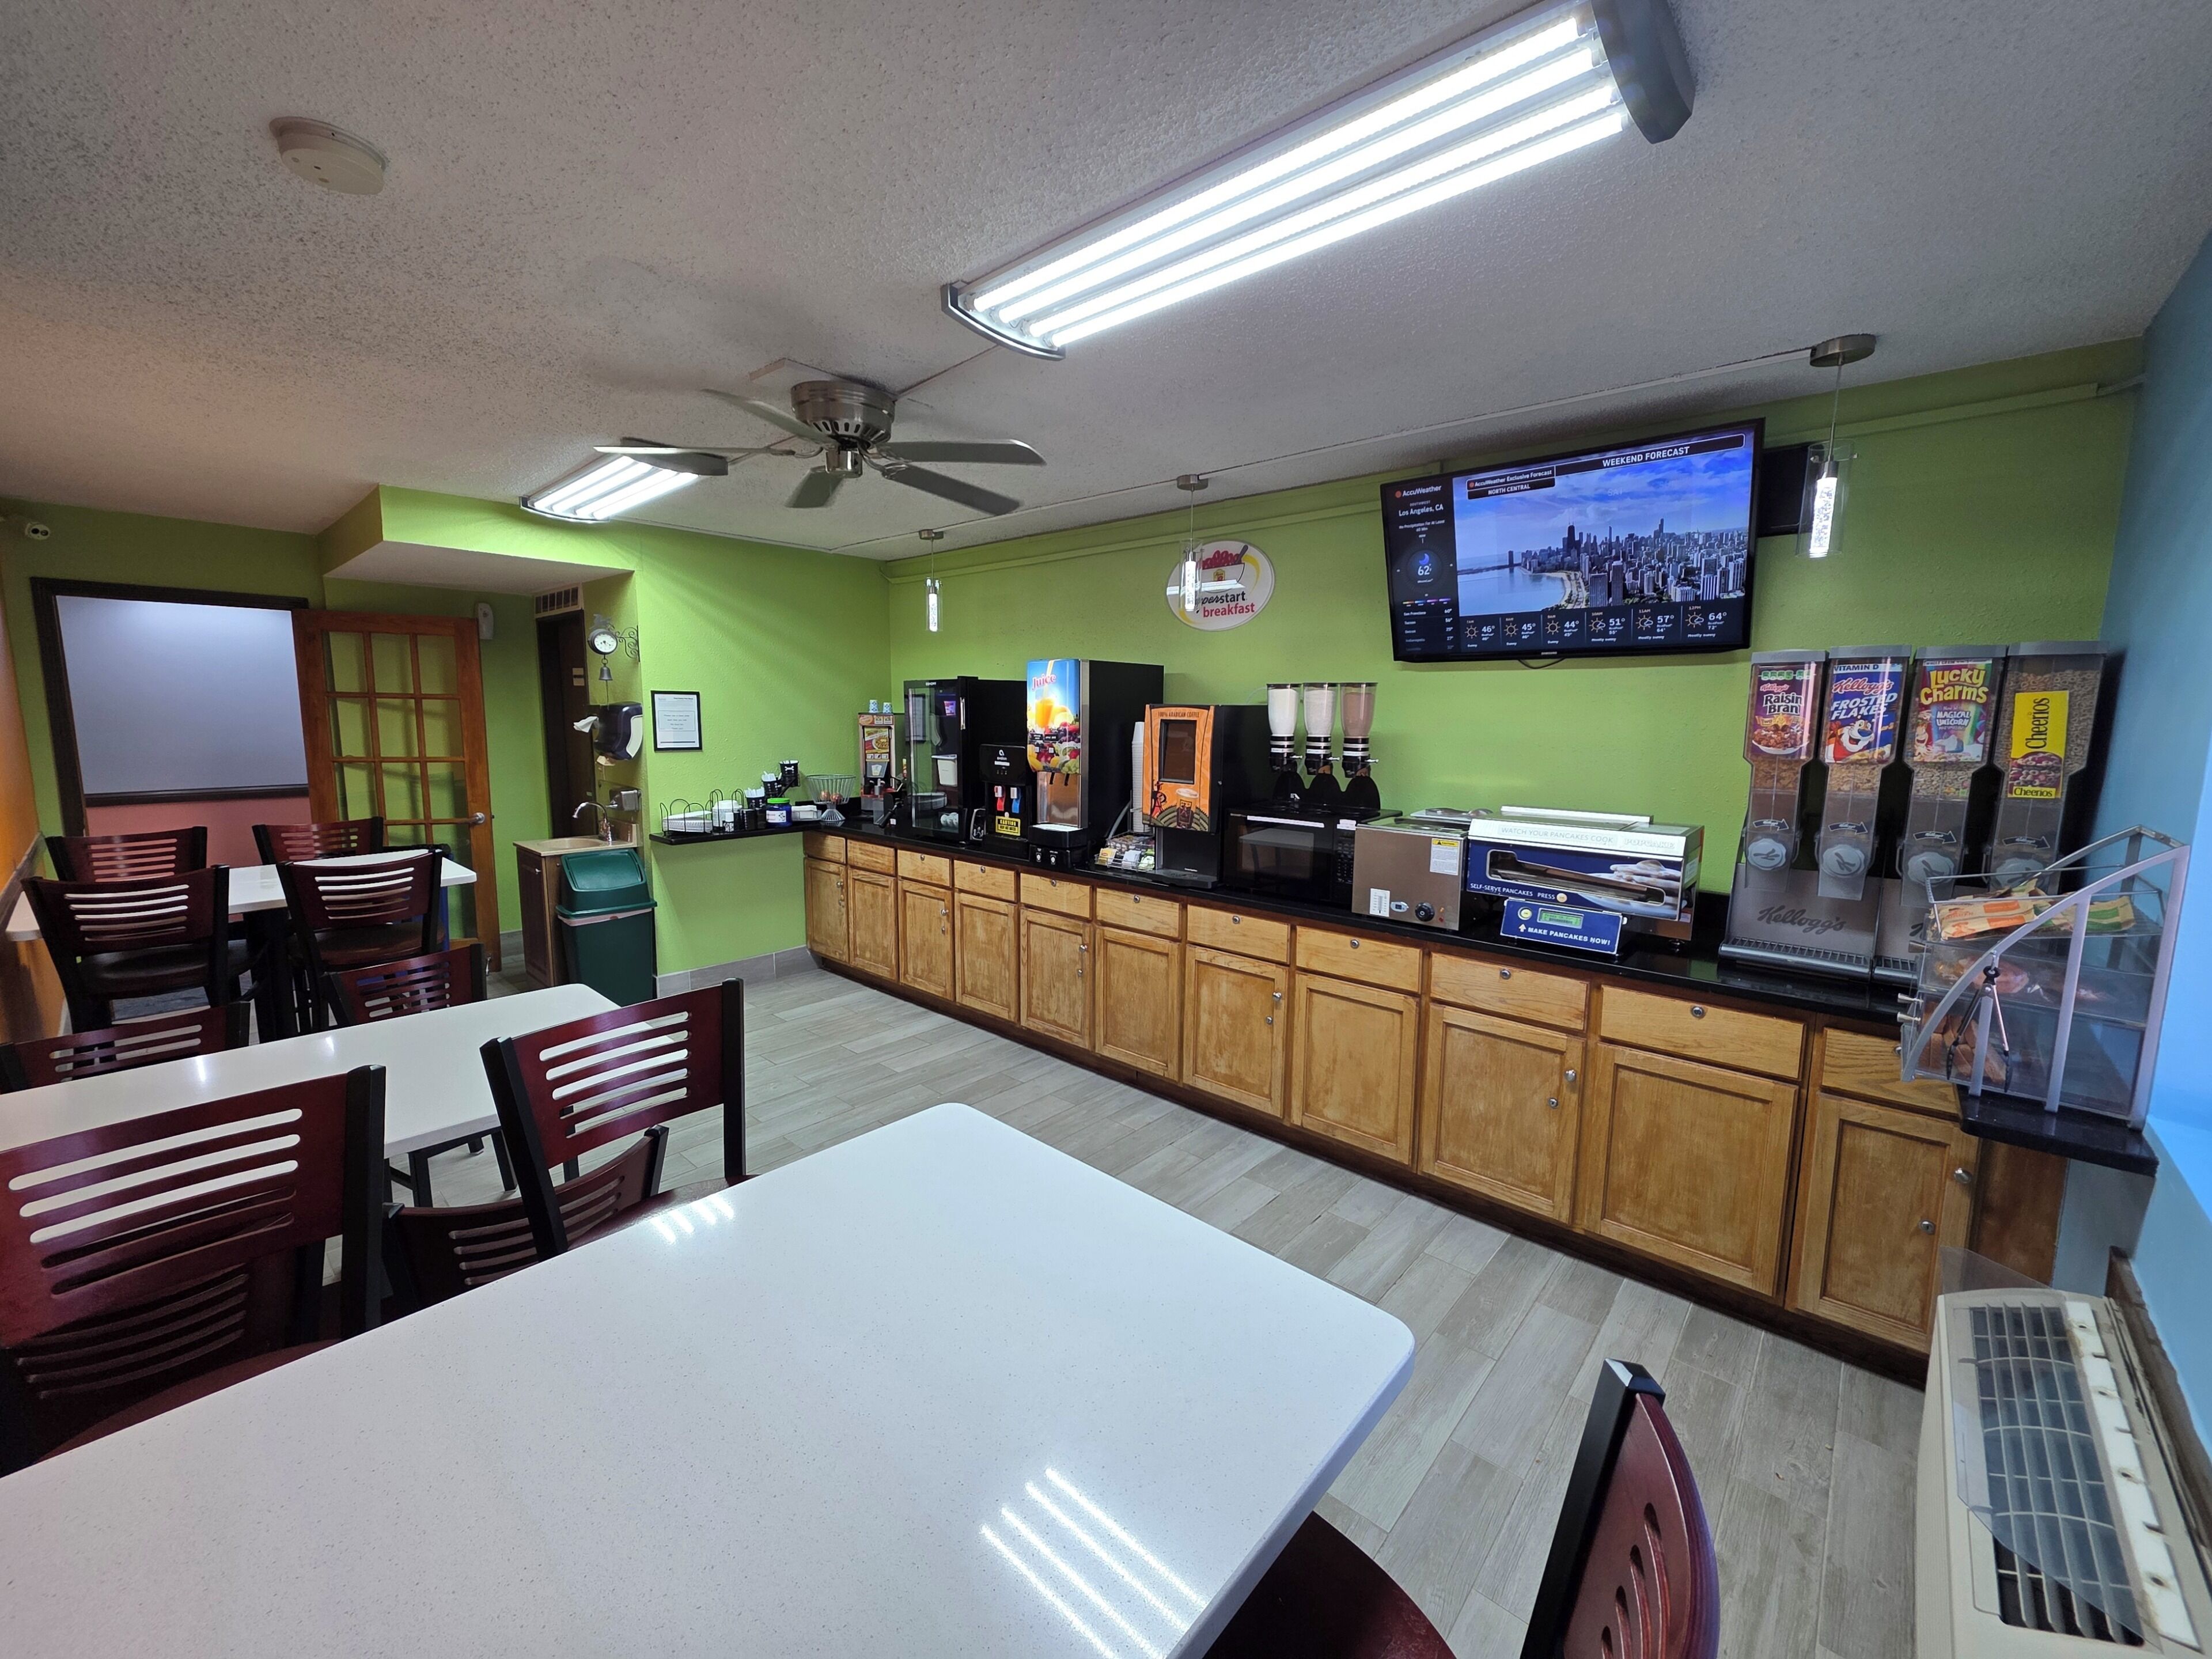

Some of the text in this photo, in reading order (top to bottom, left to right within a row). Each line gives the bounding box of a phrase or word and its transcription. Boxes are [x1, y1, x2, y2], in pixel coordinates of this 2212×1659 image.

[1603, 445, 1690, 467] WEEKEND FORECAST
[1474, 469, 1552, 487] AccuWeather Exclusive Forecast
[1403, 486, 1442, 497] AccuWeather
[1488, 483, 1531, 495] NORTH CENTRAL
[1410, 506, 1434, 515] Angeles,
[1203, 603, 1255, 618] breakfast
[1709, 612, 1727, 621] 64°
[1609, 618, 1626, 626] 51°
[1657, 615, 1675, 623] 57°
[1032, 674, 1056, 691] Juice
[1832, 677, 1894, 695] Kellogg's
[1930, 668, 1986, 689] Lucky
[1760, 683, 1789, 692] Kellogg's
[1920, 685, 1989, 705] Charms
[1764, 693, 1804, 706] Raisin
[1831, 692, 1898, 711] FROSTED
[1768, 704, 1800, 715] Bran
[1831, 703, 1888, 720] FLAKES
[2025, 698, 2050, 749] Cheerios
[2014, 787, 2053, 797] Cheerios
[1501, 827, 1527, 835] WATCH
[1550, 831, 1589, 841] PANCAKES
[1590, 835, 1614, 845] COOK
[1624, 838, 1675, 850] POPCAKE
[1470, 882, 1501, 892] SELF-SERVE
[1502, 887, 1533, 896] PANCAKES
[1757, 905, 1847, 935] Kellogg's
[1550, 930, 1589, 942] PANCAKES
[1590, 937, 1611, 945] NOW!
